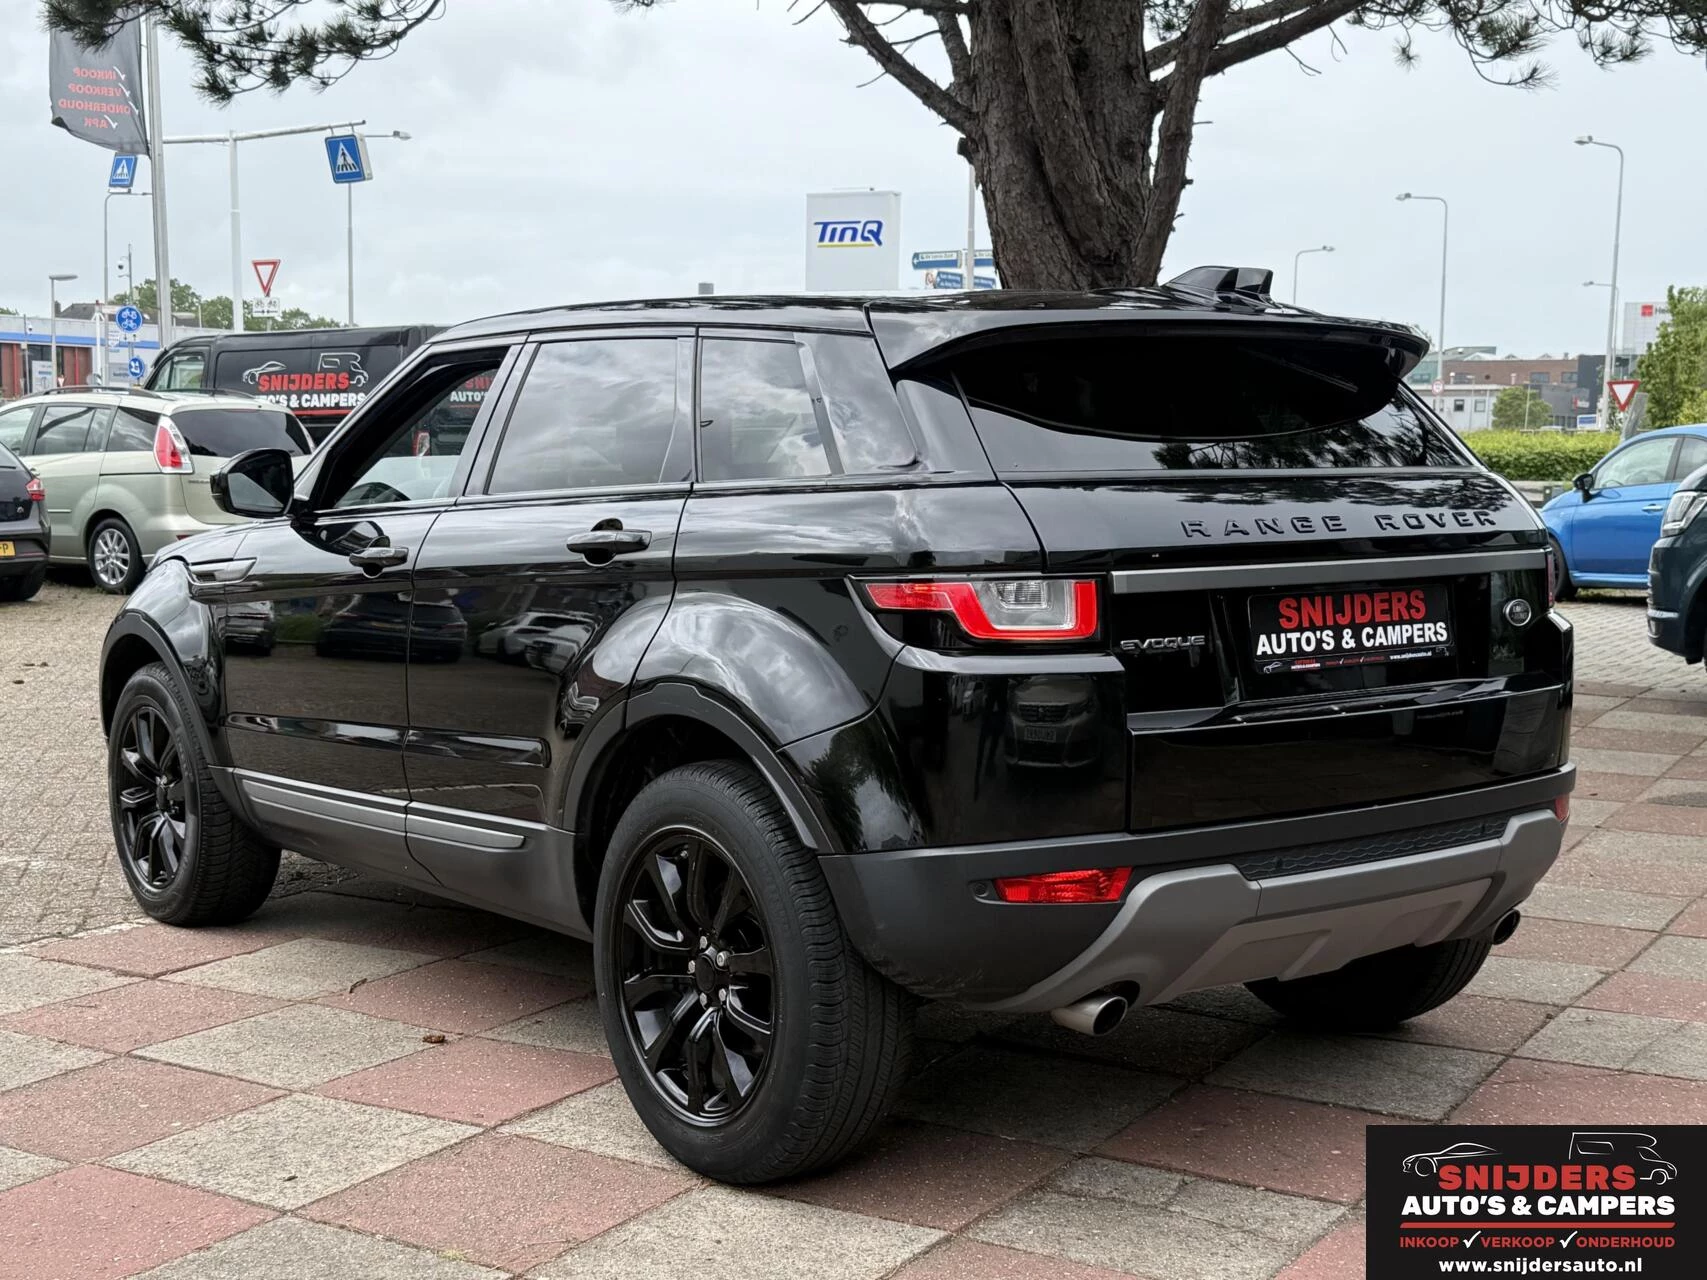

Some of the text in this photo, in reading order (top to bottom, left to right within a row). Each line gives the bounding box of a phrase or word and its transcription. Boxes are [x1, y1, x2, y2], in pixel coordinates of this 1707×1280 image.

[258, 371, 350, 392] SNIJDERS
[289, 394, 300, 408] &
[301, 392, 367, 408] CAMPERS
[1180, 511, 1496, 538] RANGE ROVER
[1279, 589, 1426, 629] SNIJDERS
[1120, 635, 1205, 650] EVOQUE
[1256, 621, 1448, 656] AUTO'S & CAMPERS
